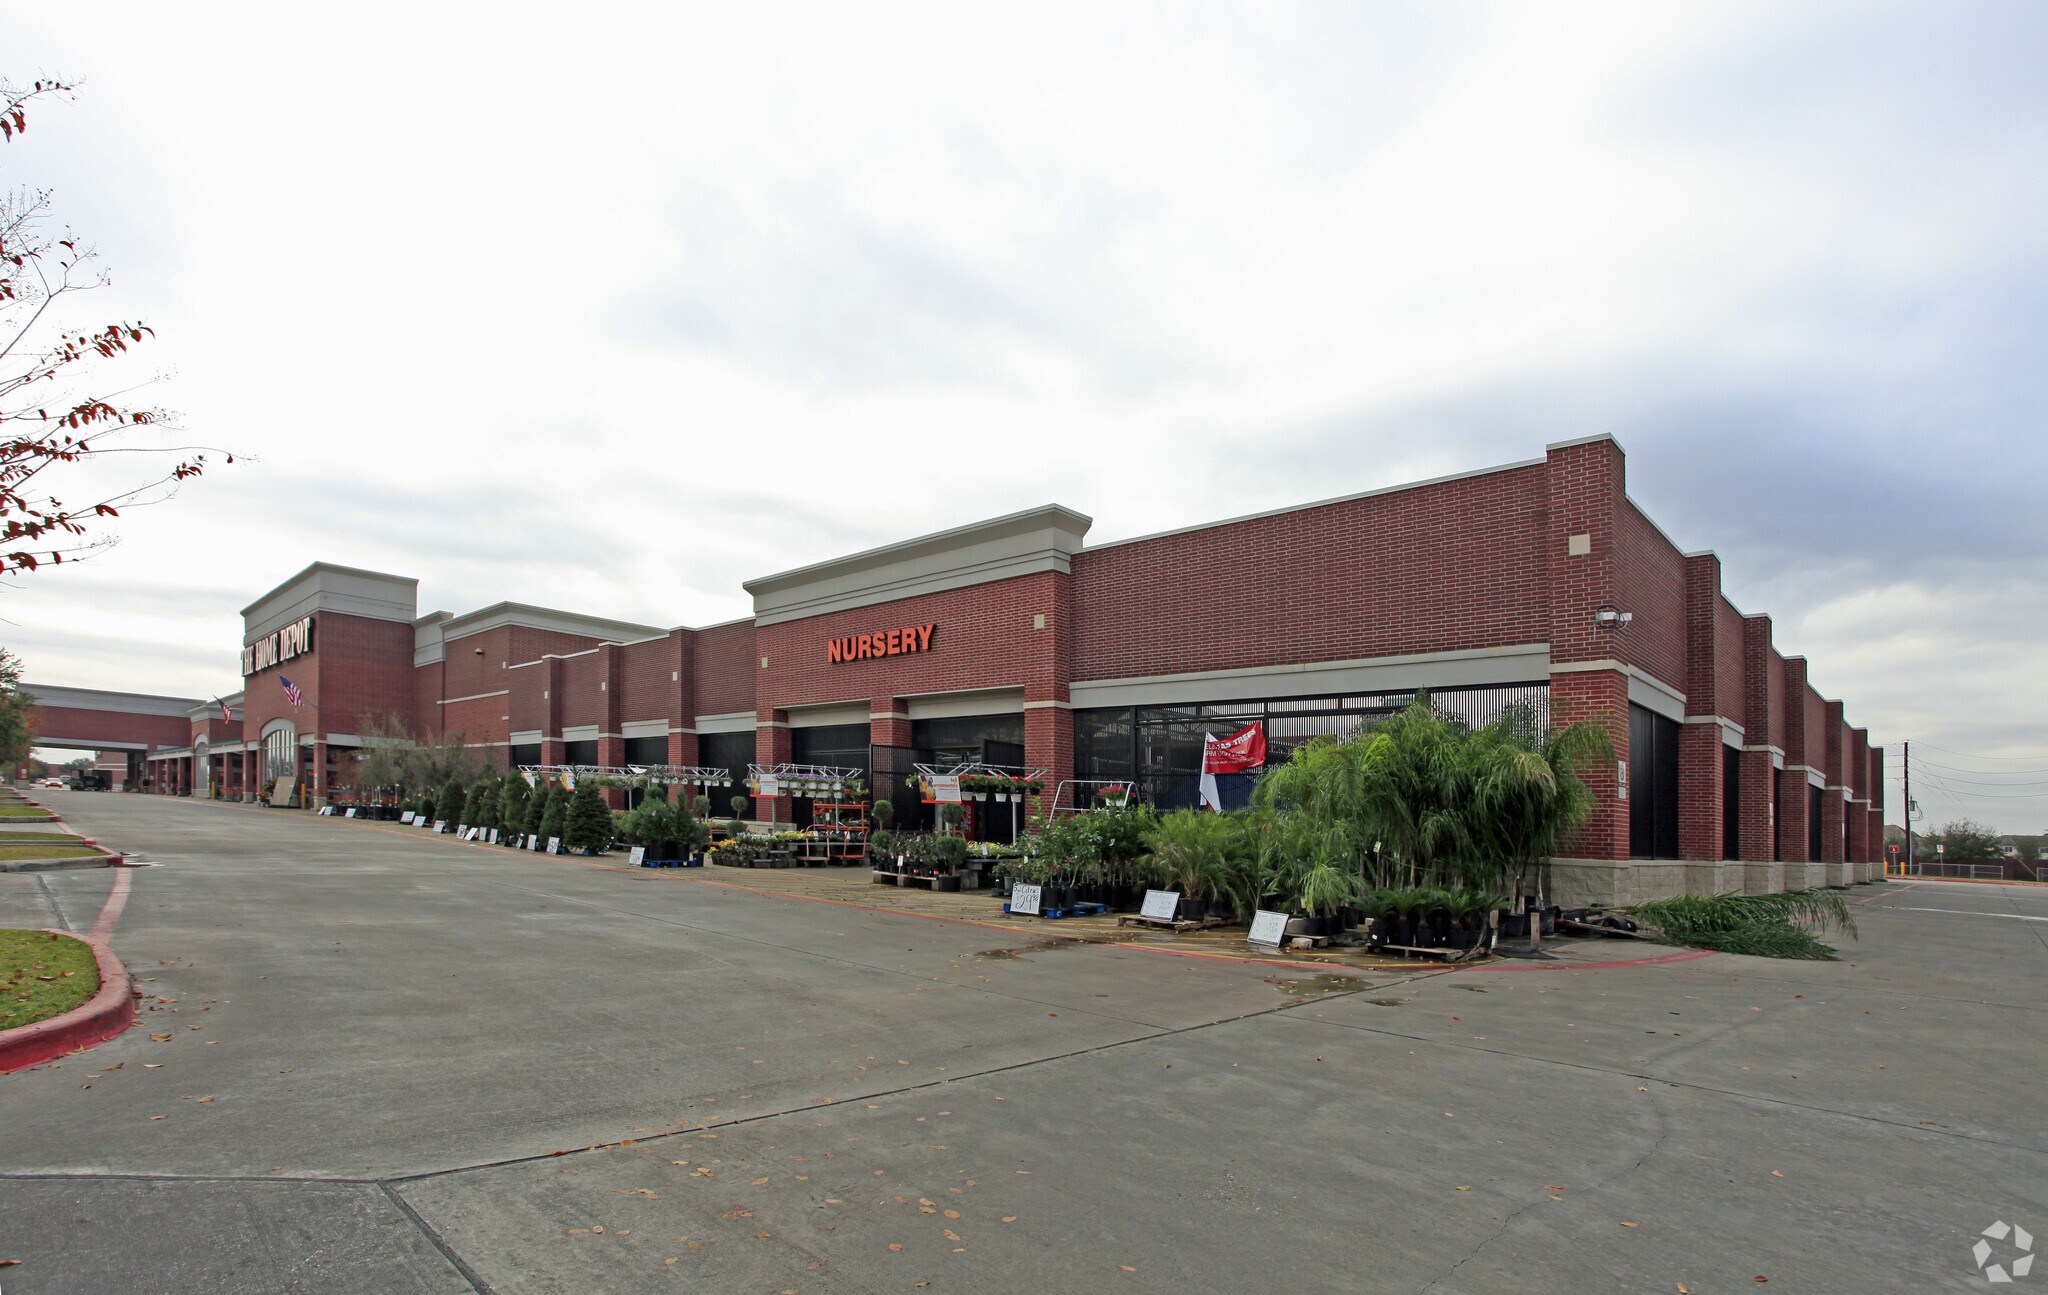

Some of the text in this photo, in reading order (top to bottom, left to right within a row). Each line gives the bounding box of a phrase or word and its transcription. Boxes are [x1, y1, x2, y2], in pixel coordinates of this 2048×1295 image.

[241, 617, 311, 677] THE HOME DEPOT
[827, 623, 936, 662] NURSERY
